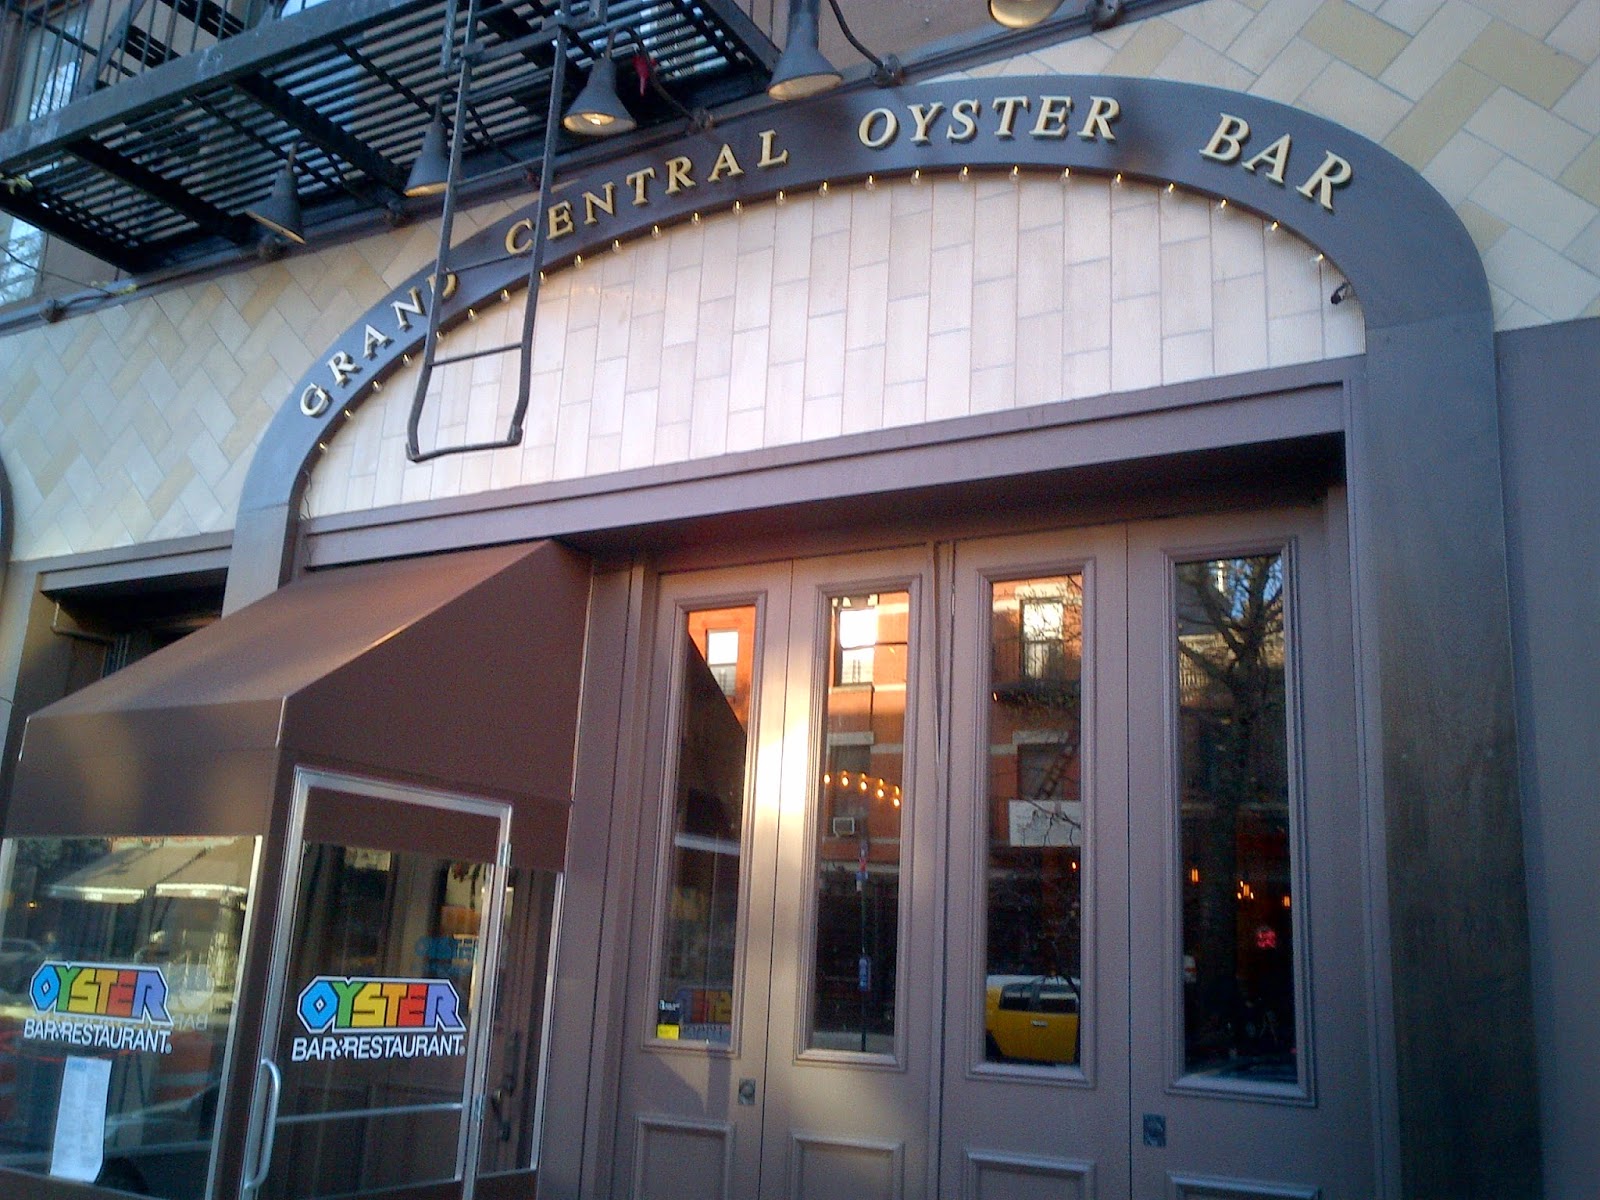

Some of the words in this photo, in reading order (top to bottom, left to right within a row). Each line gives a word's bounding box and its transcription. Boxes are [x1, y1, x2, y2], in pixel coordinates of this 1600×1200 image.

[504, 129, 789, 256] CENTRAL
[857, 95, 1121, 149] OYSTER
[1199, 111, 1353, 211] BAR
[29, 961, 174, 1026] OYSTER
[297, 976, 467, 1033] OYSTER
